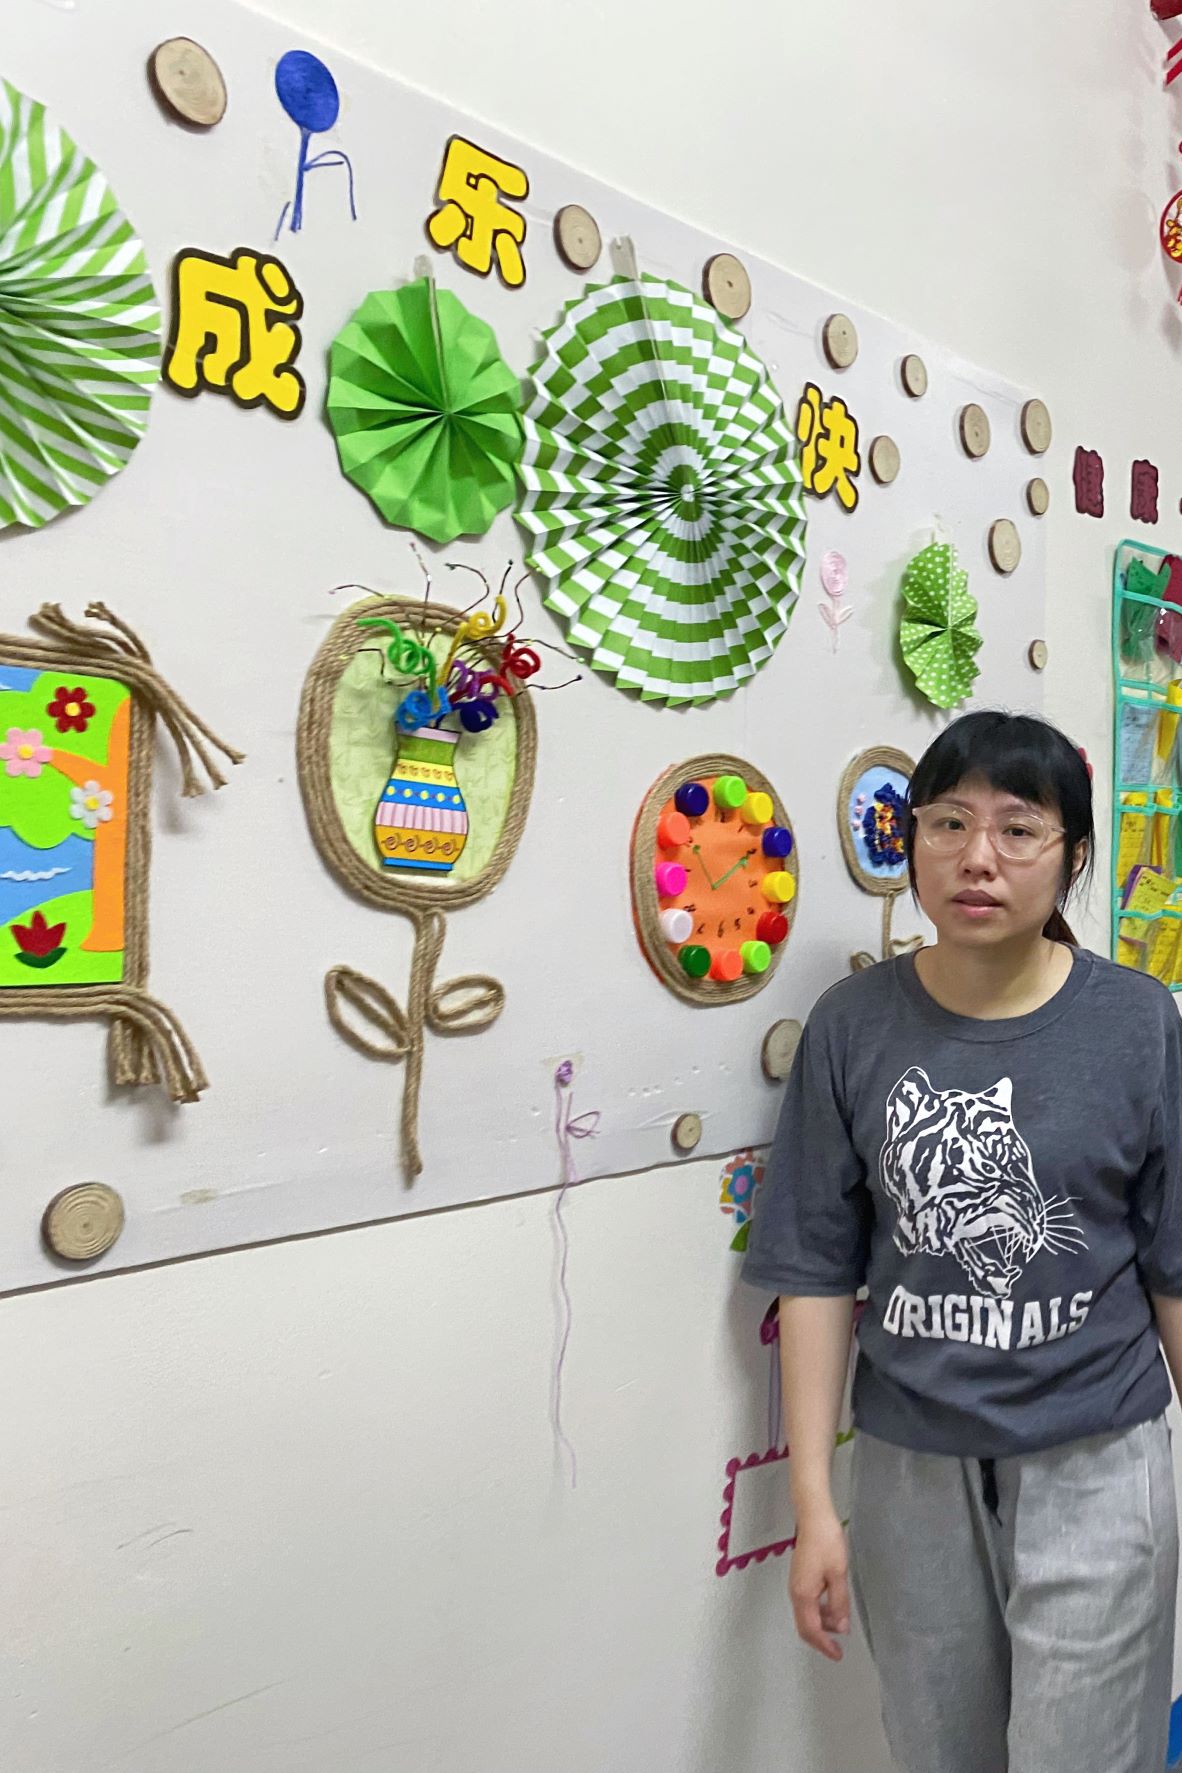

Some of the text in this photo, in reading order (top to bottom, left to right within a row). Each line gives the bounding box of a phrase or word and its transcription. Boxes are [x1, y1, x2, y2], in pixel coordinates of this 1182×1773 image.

[425, 134, 529, 289] 乐
[162, 247, 305, 420] 成
[796, 381, 861, 513] 快
[882, 1285, 1093, 1350] ORIGINALS
